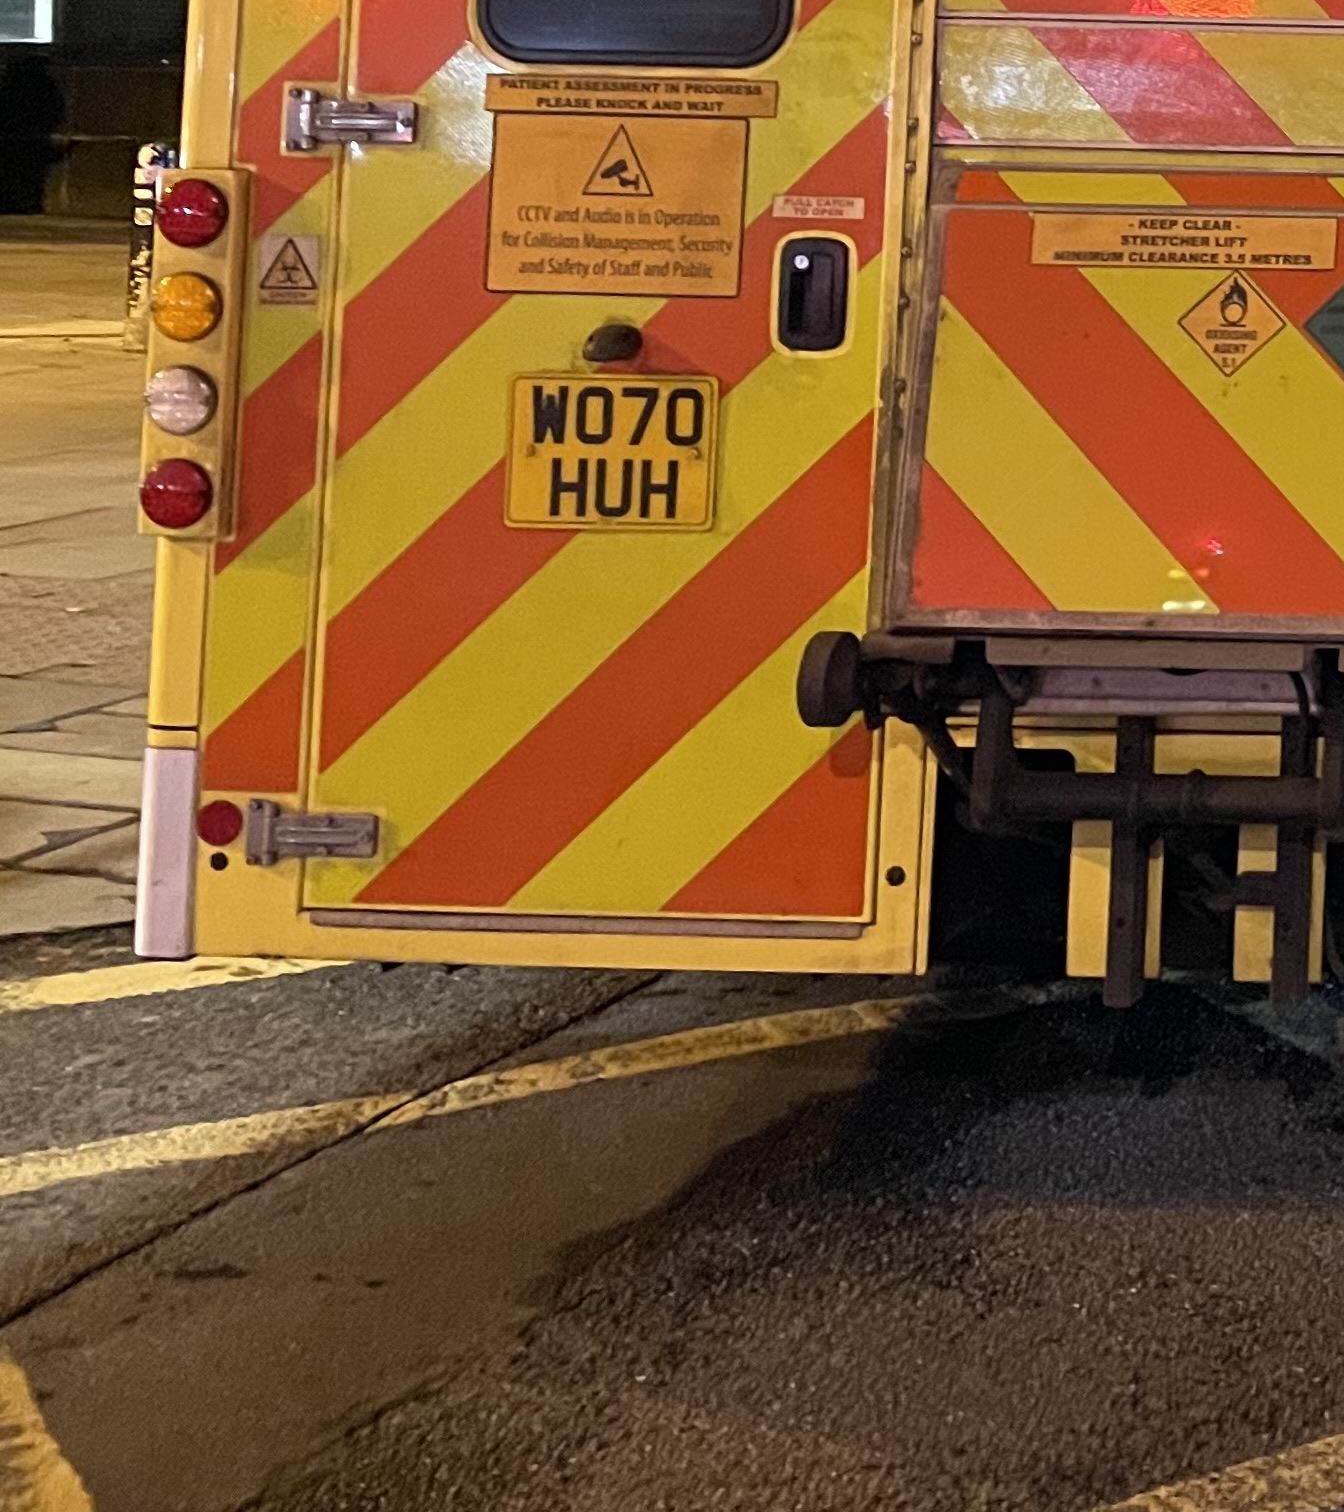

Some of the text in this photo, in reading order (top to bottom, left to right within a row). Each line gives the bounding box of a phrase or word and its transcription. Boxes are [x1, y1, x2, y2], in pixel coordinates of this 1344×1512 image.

[501, 80, 762, 95] PATIENT ASSESSMENT IN PROGRESS
[536, 98, 724, 112] PLEASE KNOCK AND WAIT
[517, 205, 721, 227] CCTV and Audio is in Operation
[794, 208, 809, 216] TO
[1138, 219, 1179, 230] KEEP
[1182, 220, 1232, 231] CLEAR
[502, 231, 519, 247] for
[523, 232, 578, 249] Collision
[679, 235, 733, 255] Security
[1120, 235, 1247, 248] STRETCHER LIFT
[1053, 251, 1312, 266] MINIMUM CLEARANCE 3.5 METRES
[518, 258, 713, 278] and Safety of Staff and Public
[1212, 343, 1249, 354] AGENT
[532, 385, 704, 446] WO70
[549, 457, 679, 519] HUH
